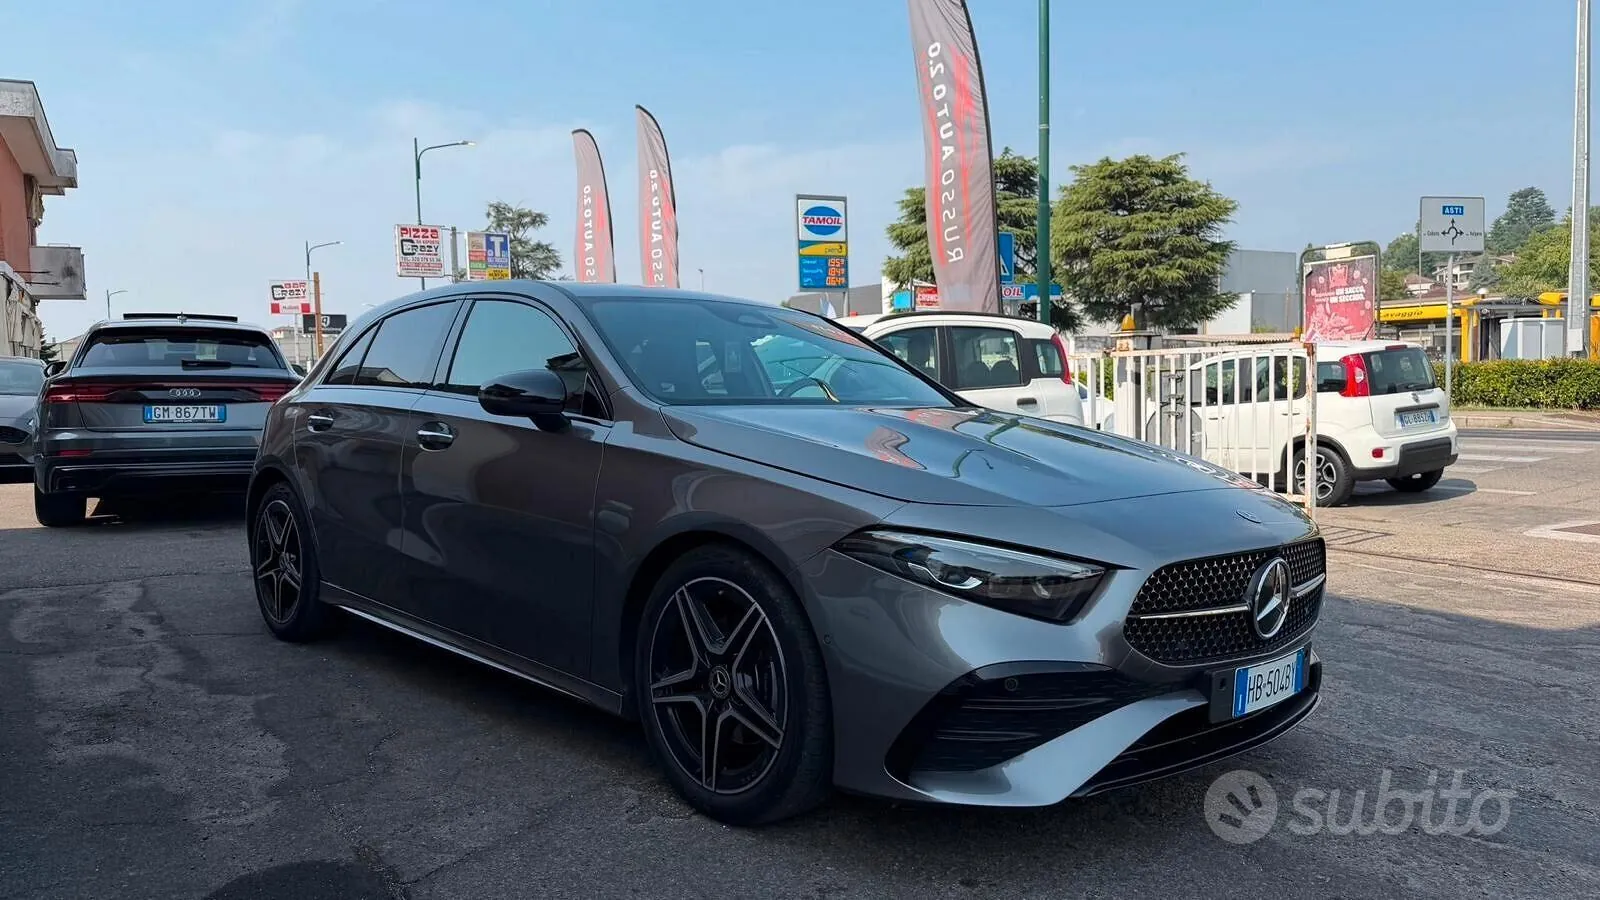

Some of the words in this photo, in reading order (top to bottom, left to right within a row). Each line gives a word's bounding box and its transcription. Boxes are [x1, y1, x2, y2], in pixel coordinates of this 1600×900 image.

[802, 216, 843, 225] TAMOIL
[400, 227, 439, 239] PIZZA
[1382, 309, 1423, 319] avaggio
